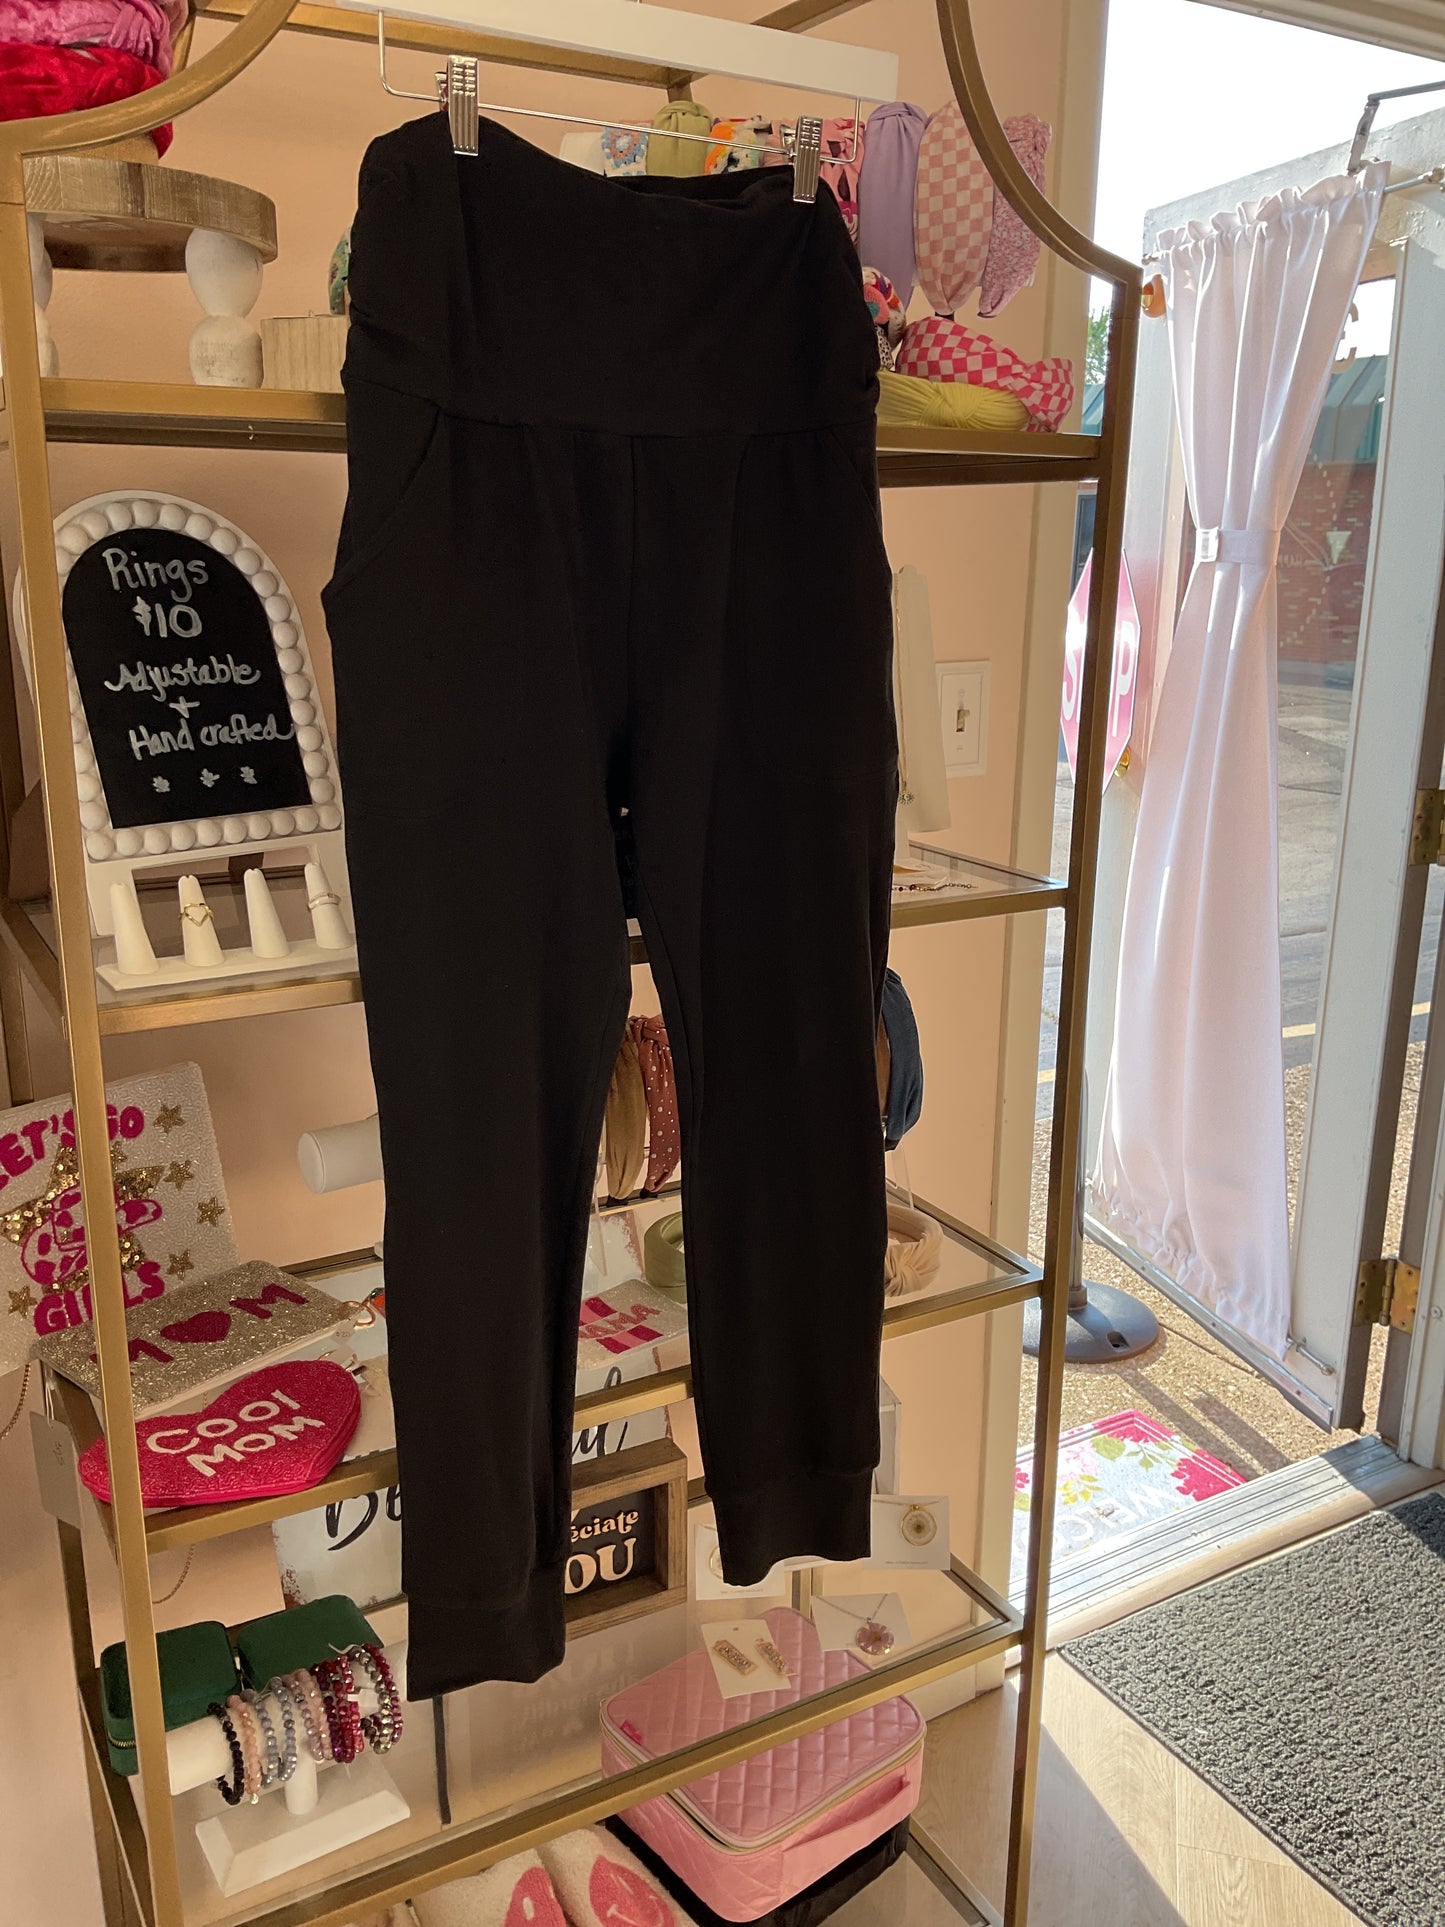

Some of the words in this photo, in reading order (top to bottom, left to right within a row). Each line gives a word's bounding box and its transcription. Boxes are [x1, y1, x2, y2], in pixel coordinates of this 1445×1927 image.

[102, 548, 209, 602] Rings
[132, 595, 203, 638] $10
[104, 654, 262, 702] Adjustable
[1062, 608, 1136, 738] SP
[129, 718, 195, 761] Hand
[578, 1303, 662, 1339] AMA
[187, 1416, 325, 1477] MOM
[570, 1511, 639, 1543] eciate
[564, 1537, 637, 1595] OU
